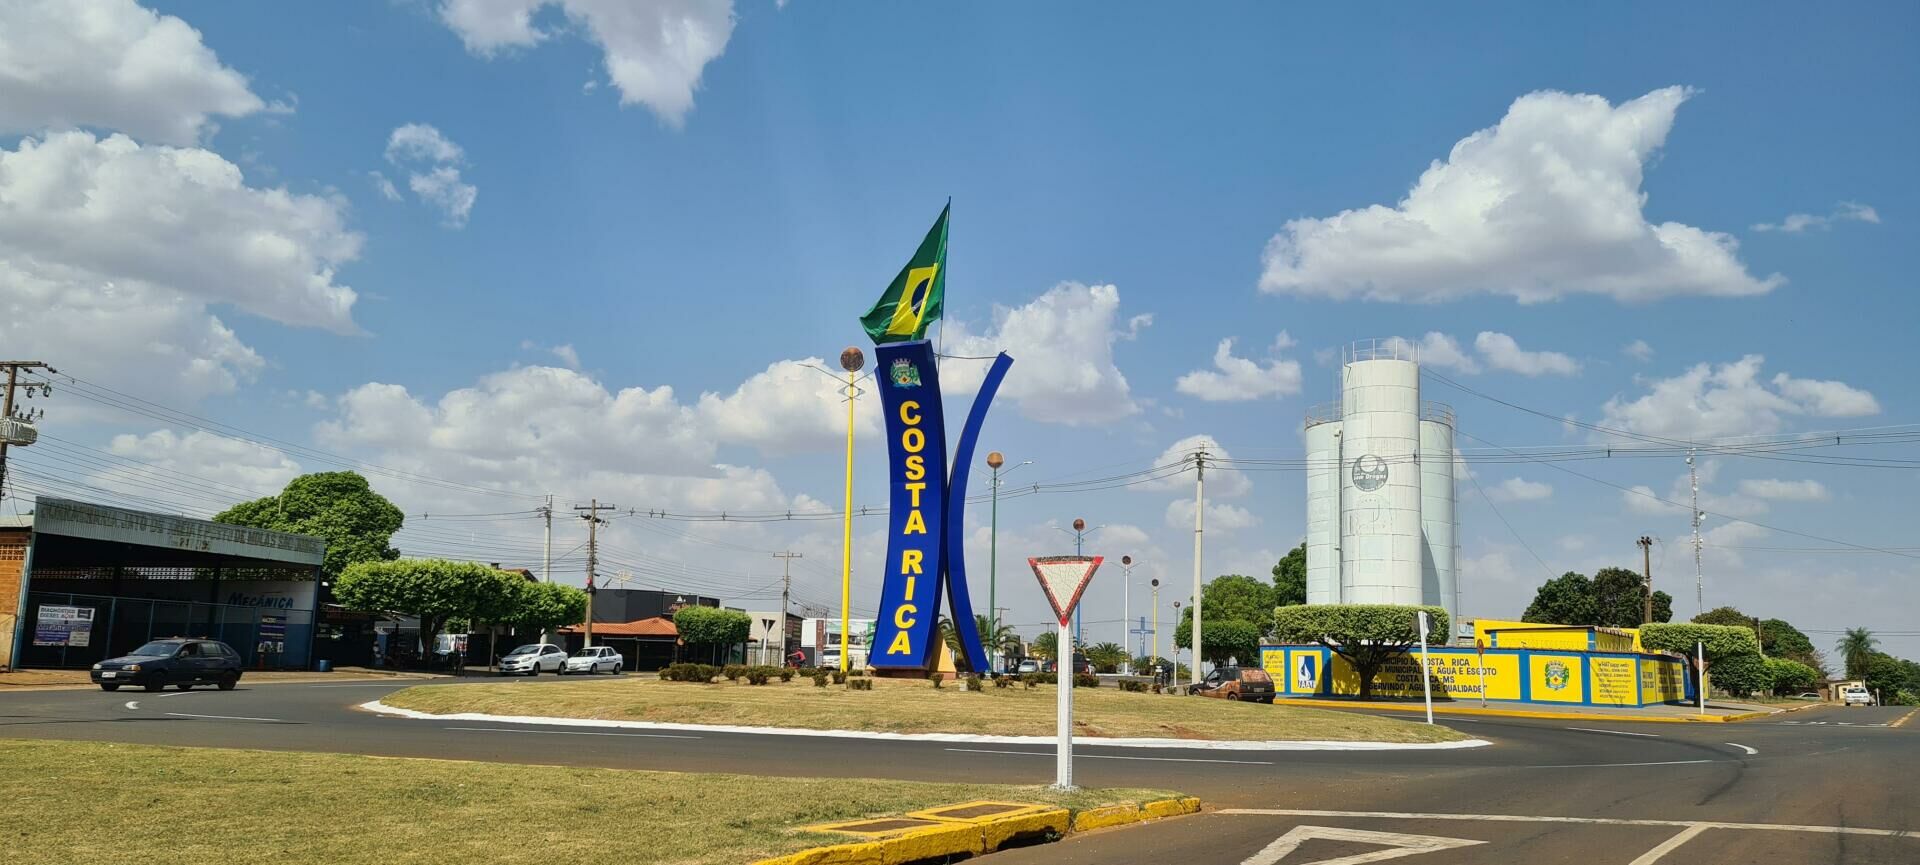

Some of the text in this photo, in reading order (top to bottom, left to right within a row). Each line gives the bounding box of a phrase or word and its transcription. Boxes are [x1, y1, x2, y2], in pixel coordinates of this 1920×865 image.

[887, 401, 928, 655] COSTA RICA
[1410, 658, 1419, 666] DE
[1451, 658, 1470, 666] RICA
[1384, 665, 1422, 674] MUNICIPAL
[1458, 667, 1464, 675] E
[1466, 667, 1497, 676] ESGOTO
[1395, 674, 1420, 683] COSTA
[1408, 683, 1426, 692] AGU
[1431, 684, 1441, 692] DE
